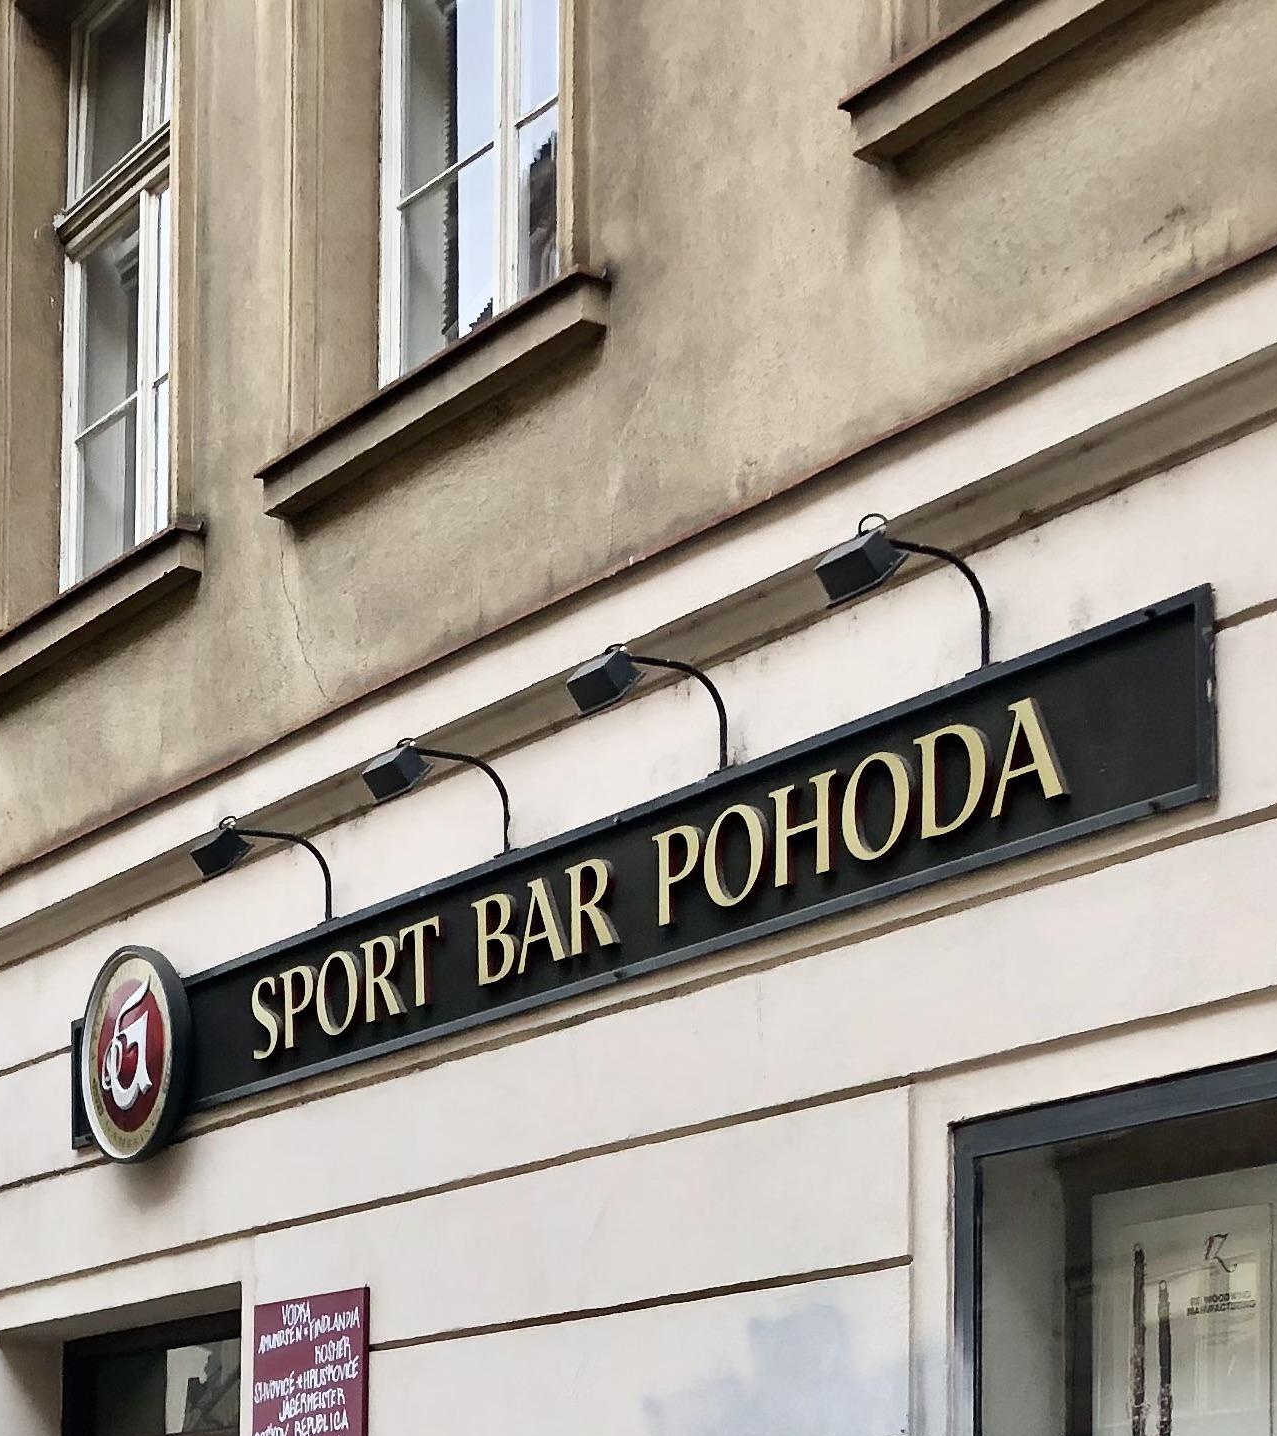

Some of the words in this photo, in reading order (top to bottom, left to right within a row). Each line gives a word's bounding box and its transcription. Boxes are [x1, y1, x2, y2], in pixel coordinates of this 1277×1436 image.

[252, 916, 441, 1060] SPORT
[472, 858, 619, 987] BAR
[651, 696, 1068, 927] POHODA
[281, 1301, 311, 1328] VODKA
[314, 1336, 352, 1365] KOSHER
